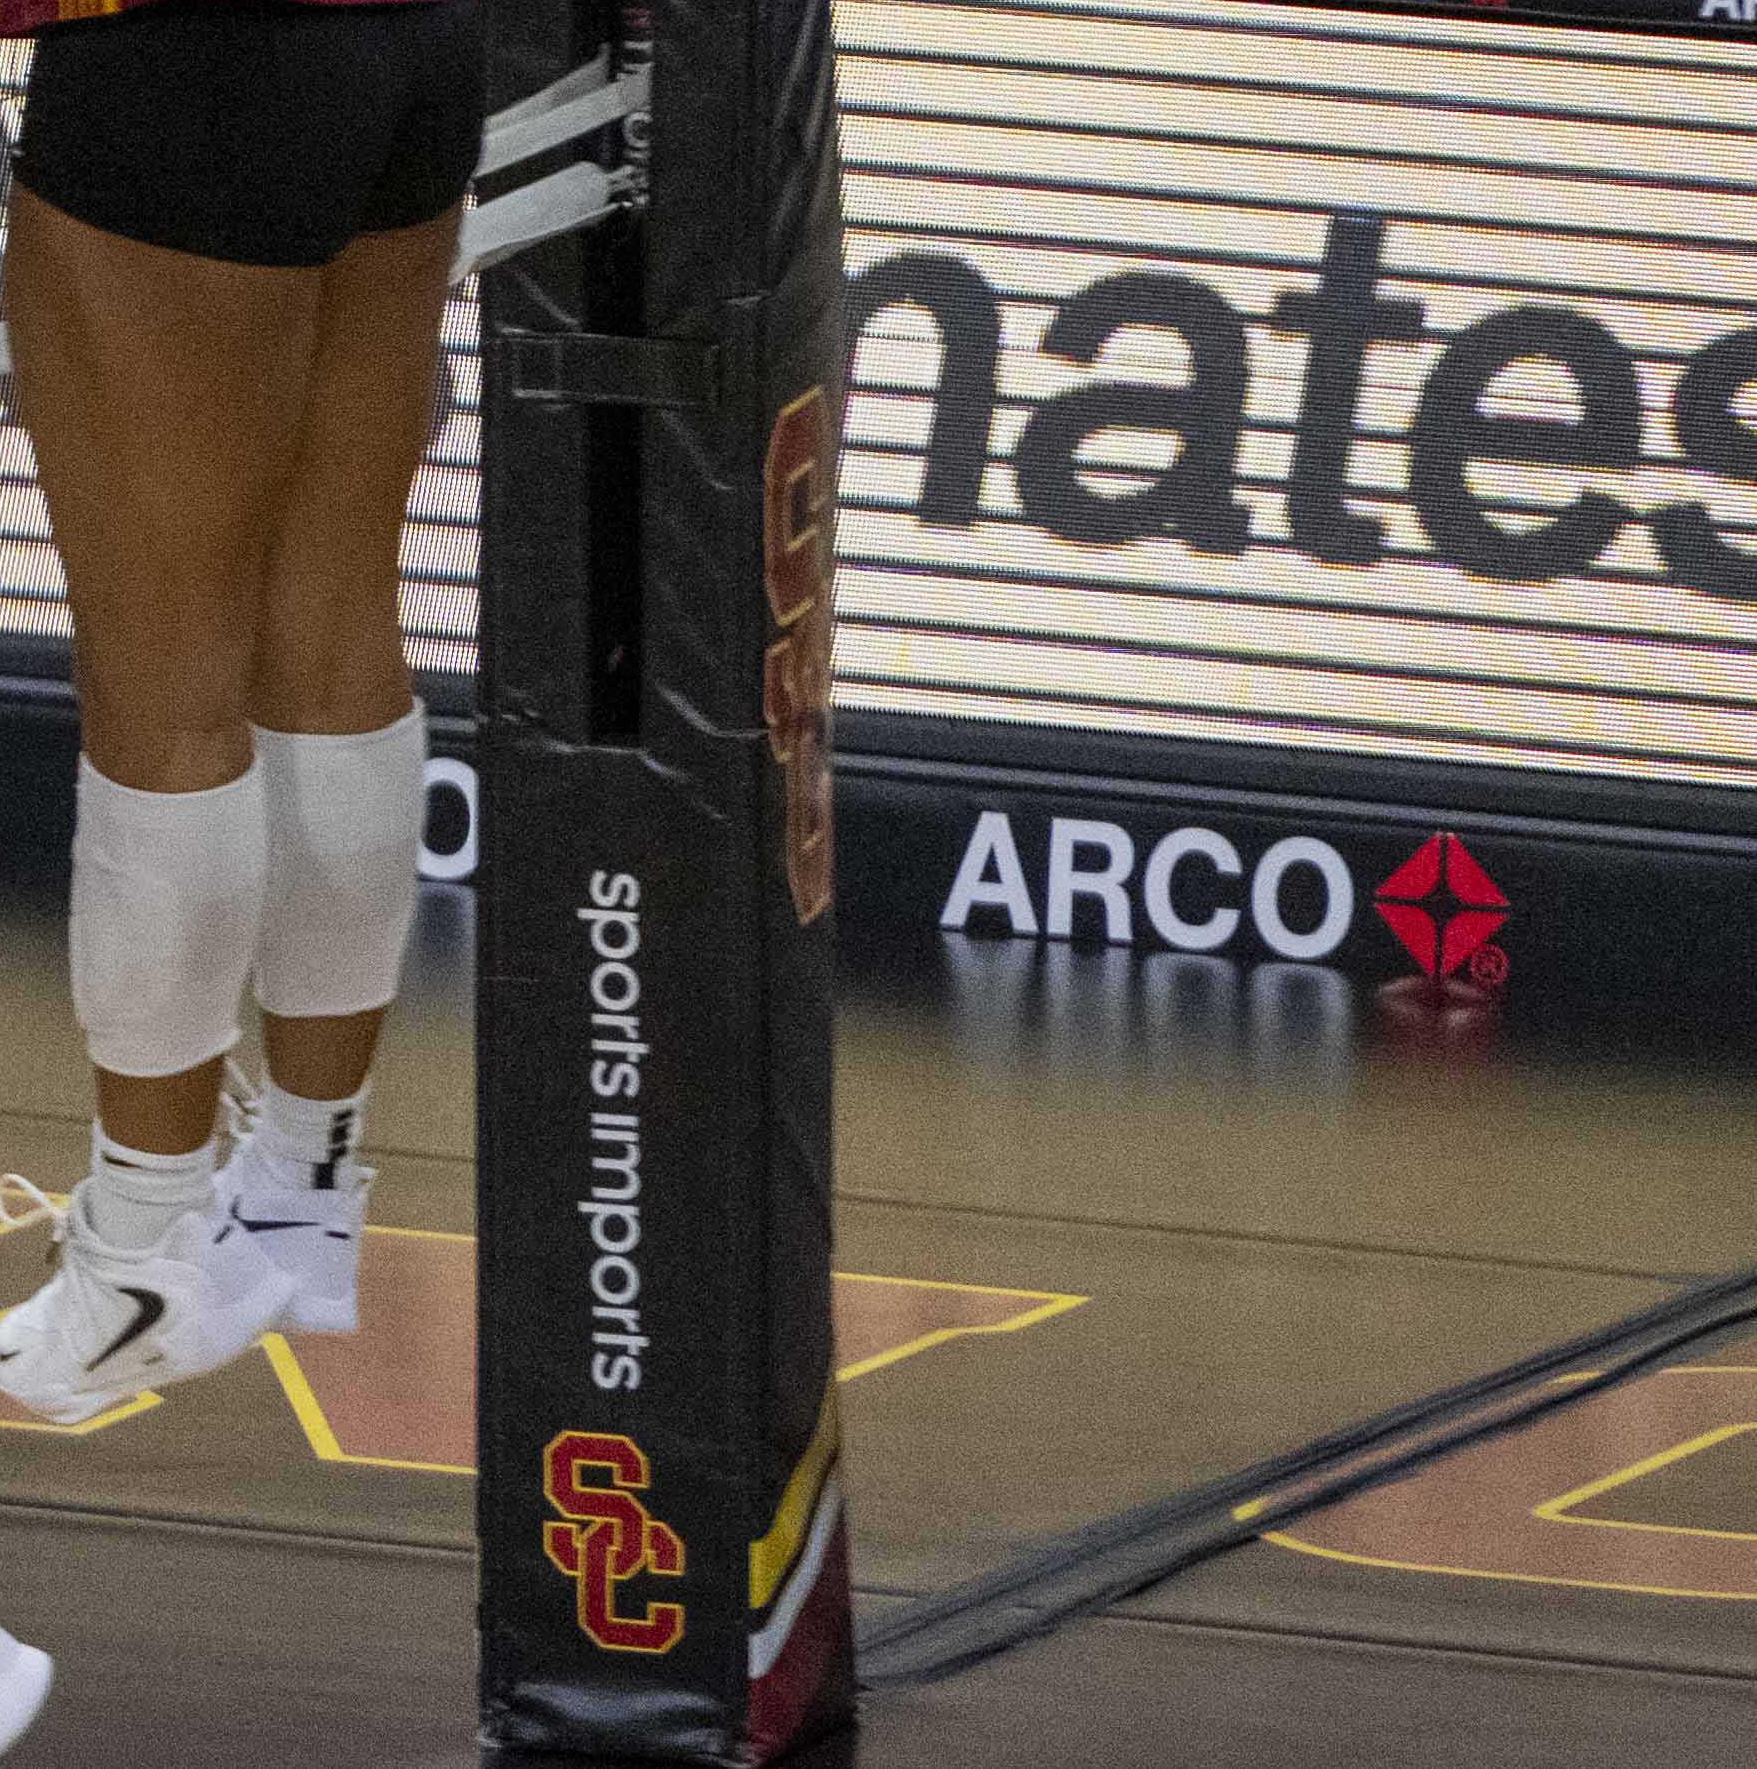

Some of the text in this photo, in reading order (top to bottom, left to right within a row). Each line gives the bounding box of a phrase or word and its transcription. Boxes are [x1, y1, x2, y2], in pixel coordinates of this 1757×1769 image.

[939, 810, 1354, 960] ARCO
[576, 869, 650, 1391] sports imports
[543, 1430, 684, 1654] SC
